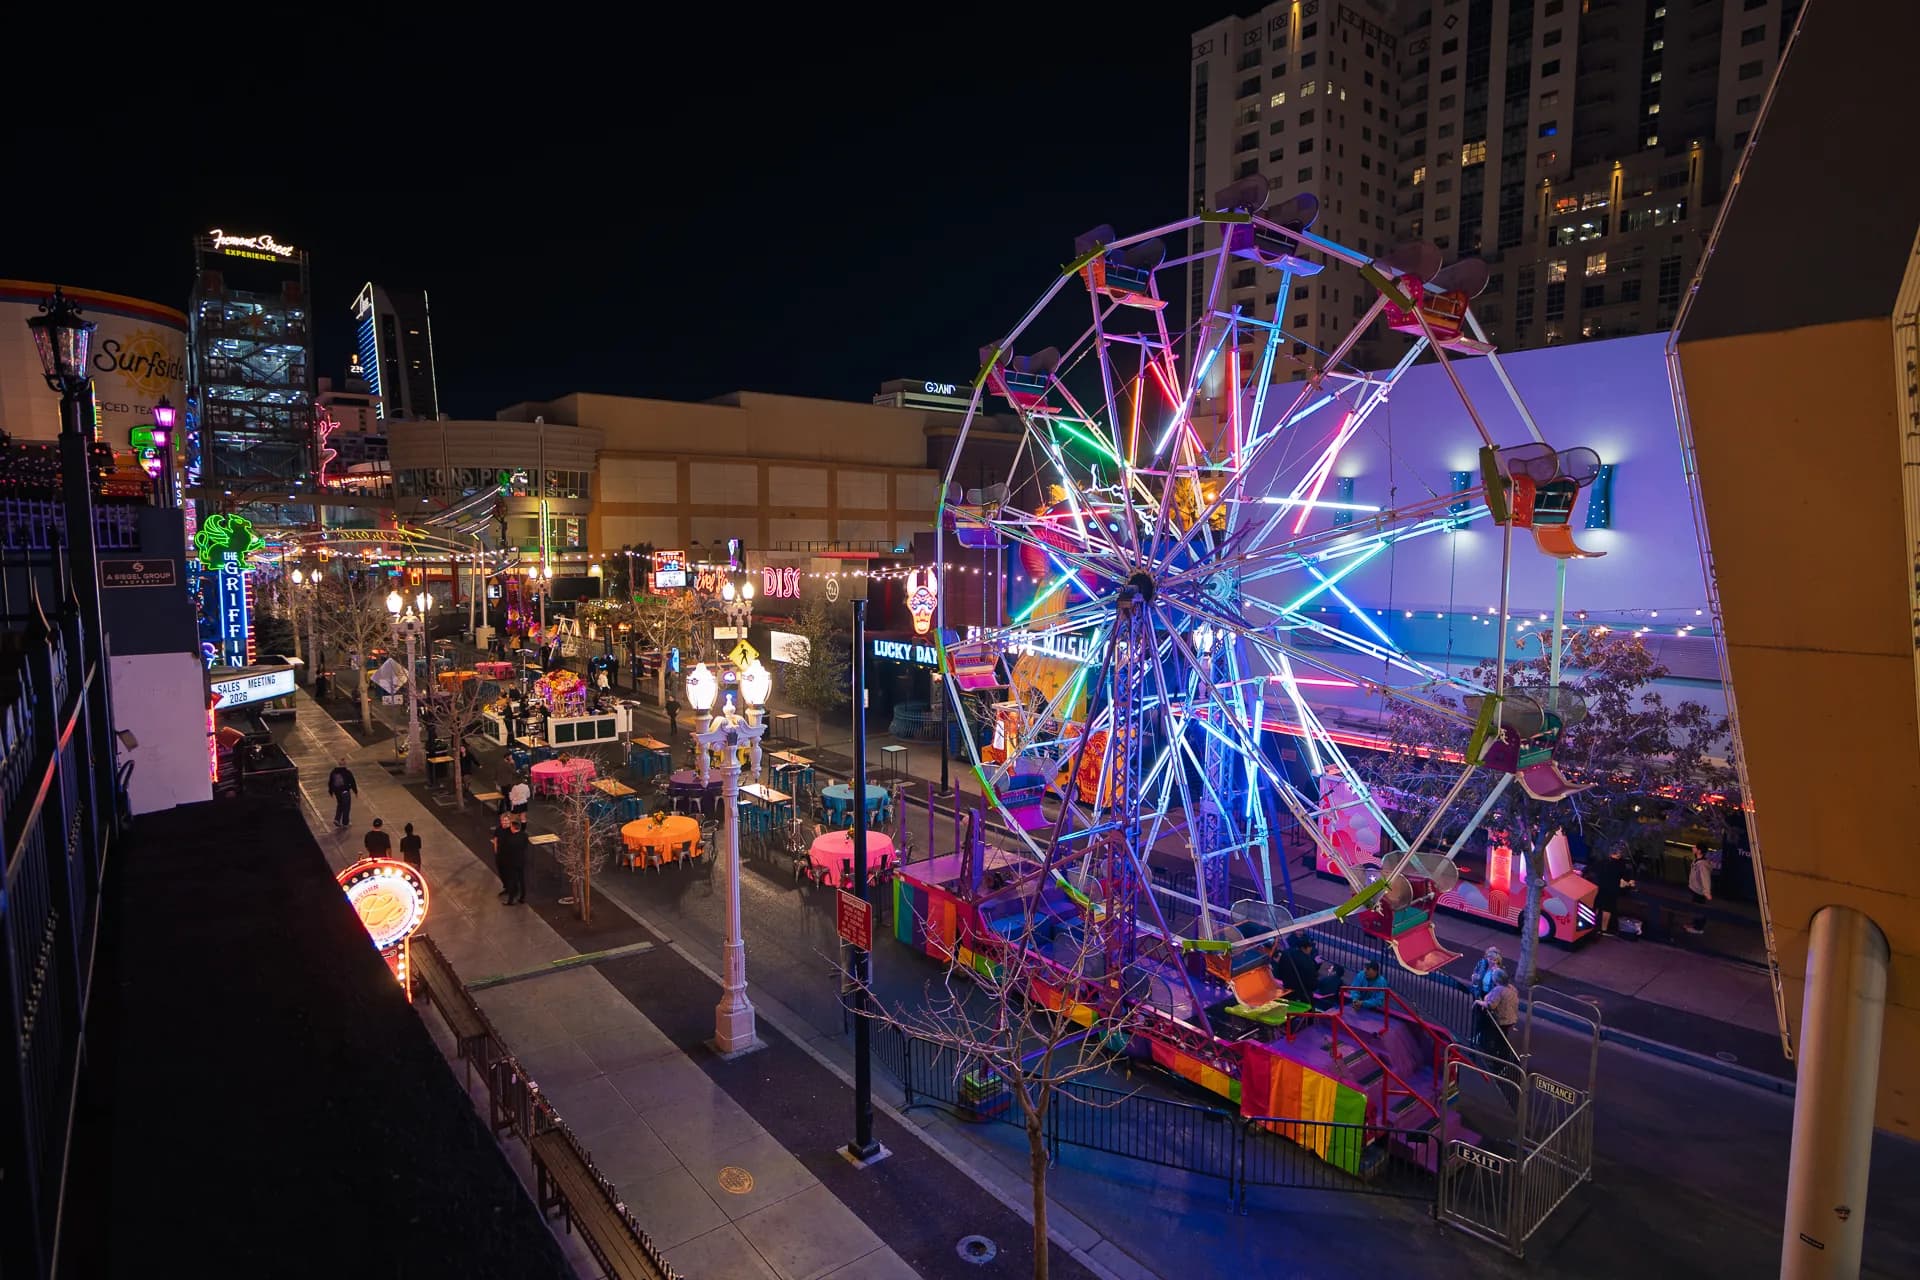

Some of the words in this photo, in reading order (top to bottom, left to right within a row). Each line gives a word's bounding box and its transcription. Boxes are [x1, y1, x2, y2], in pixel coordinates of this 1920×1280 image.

[209, 228, 257, 249] Fremont
[256, 234, 294, 257] Street
[225, 248, 277, 261] EXPERIENCE
[93, 339, 184, 382] Surfside
[223, 551, 238, 561] THE
[224, 561, 243, 668] GRIFFIN
[874, 640, 912, 660] LUCKY
[217, 682, 240, 695] SALES
[248, 675, 276, 688] MEETING
[230, 692, 248, 704] 2026
[1538, 1079, 1573, 1101] ENTRANCE
[1463, 1149, 1496, 1169] EXIT
